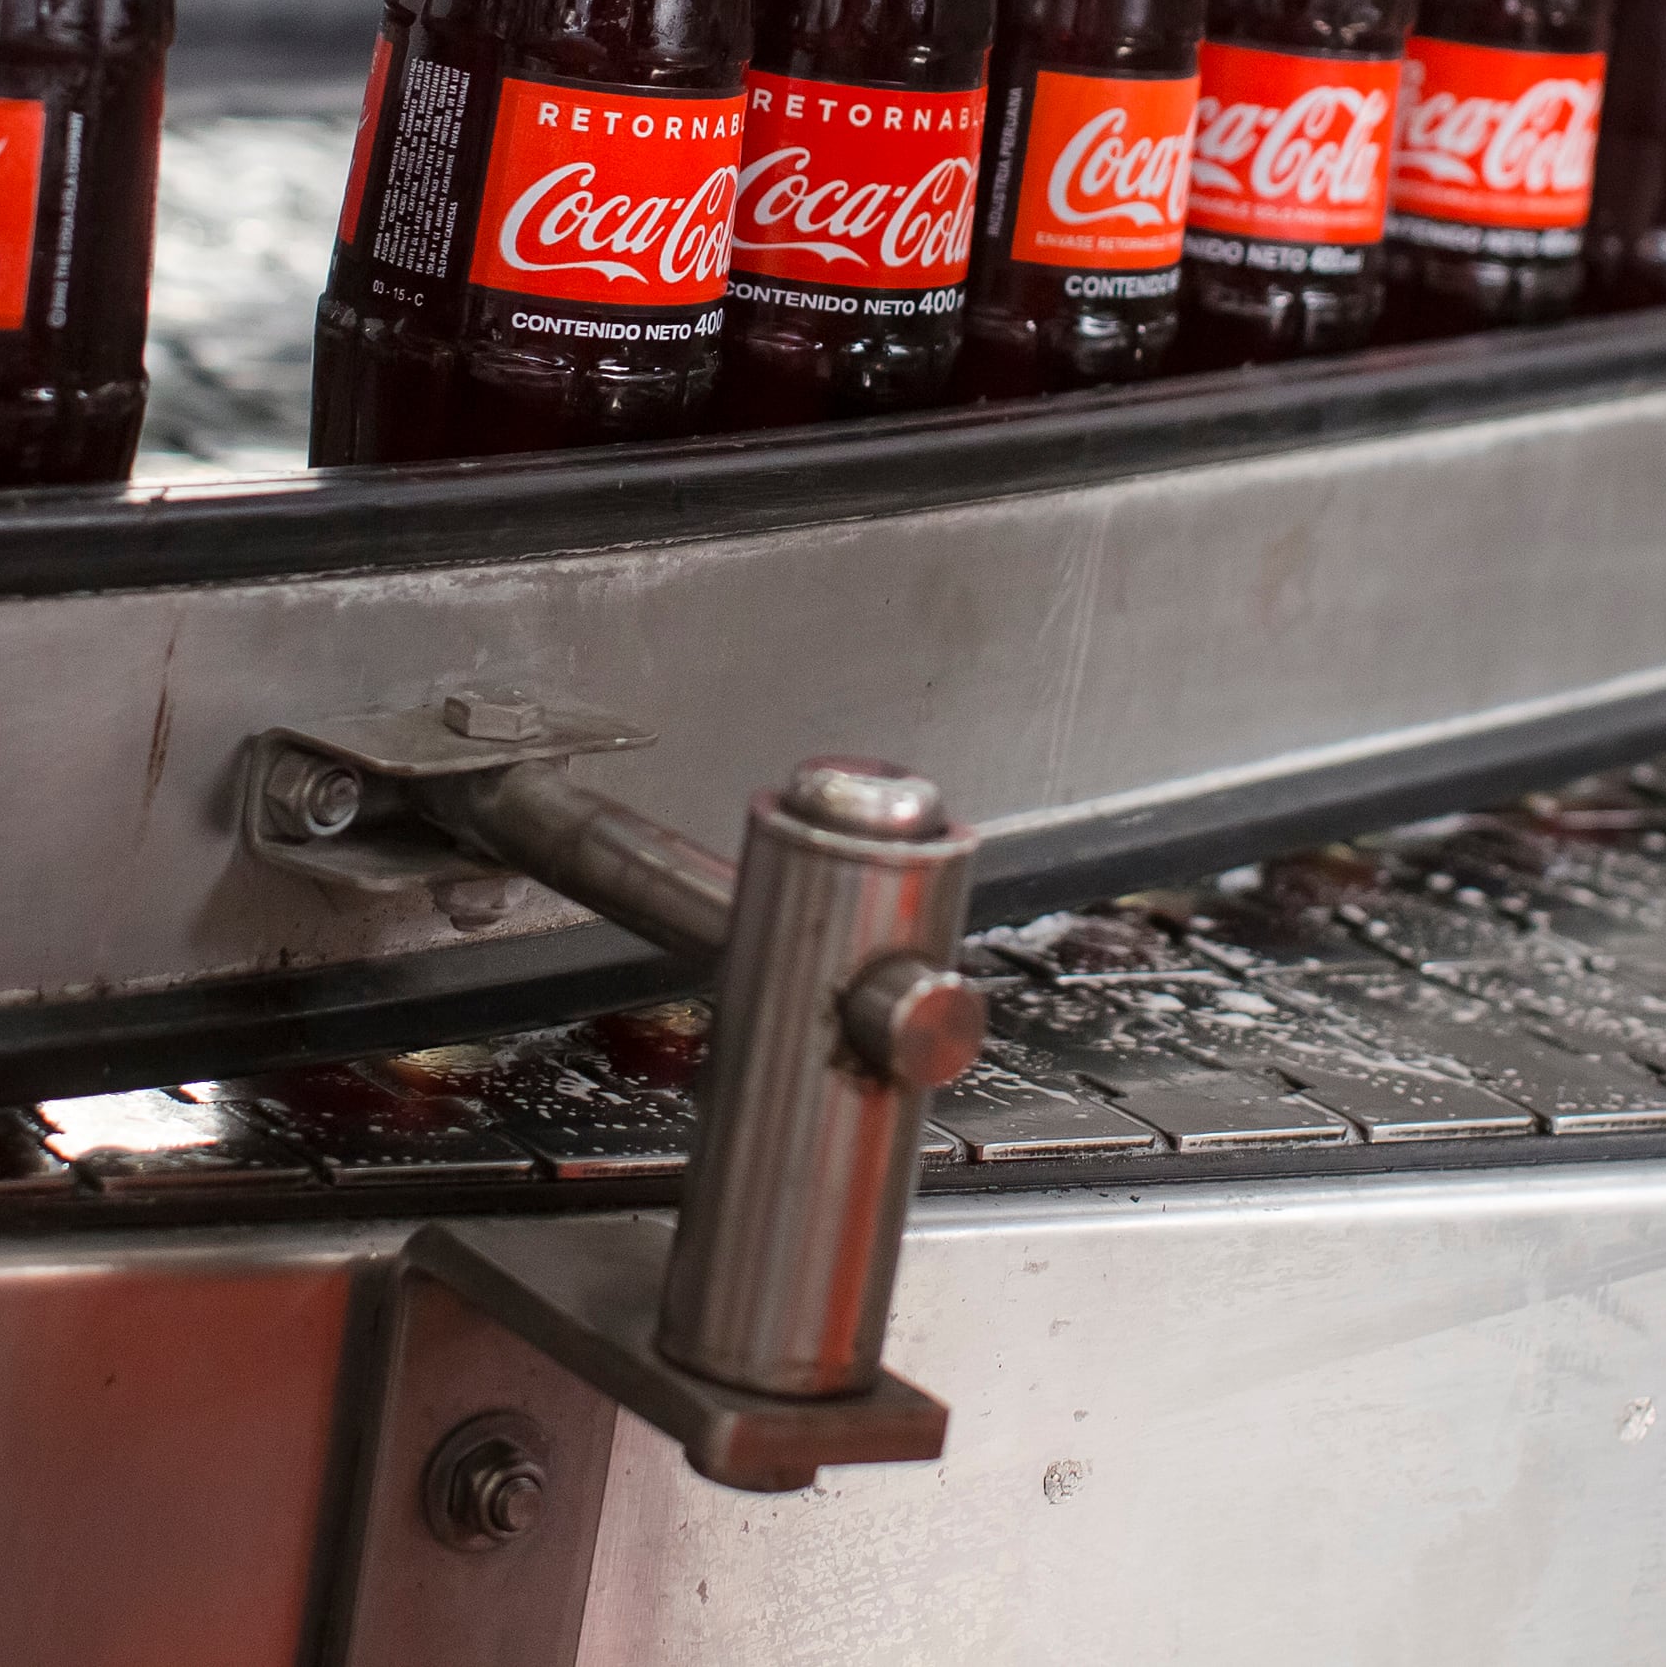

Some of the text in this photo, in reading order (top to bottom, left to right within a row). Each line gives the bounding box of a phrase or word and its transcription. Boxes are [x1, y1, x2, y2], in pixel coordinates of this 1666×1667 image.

[537, 101, 745, 141] RETORNAB
[751, 87, 980, 133] RETORNAB
[499, 161, 739, 286] Coca-Col
[414, 293, 424, 307] C
[727, 280, 859, 315] CONTENIDO
[864, 299, 916, 317] NETO
[918, 287, 957, 316] 400
[511, 307, 724, 342] CONTENIDO NETO 400
